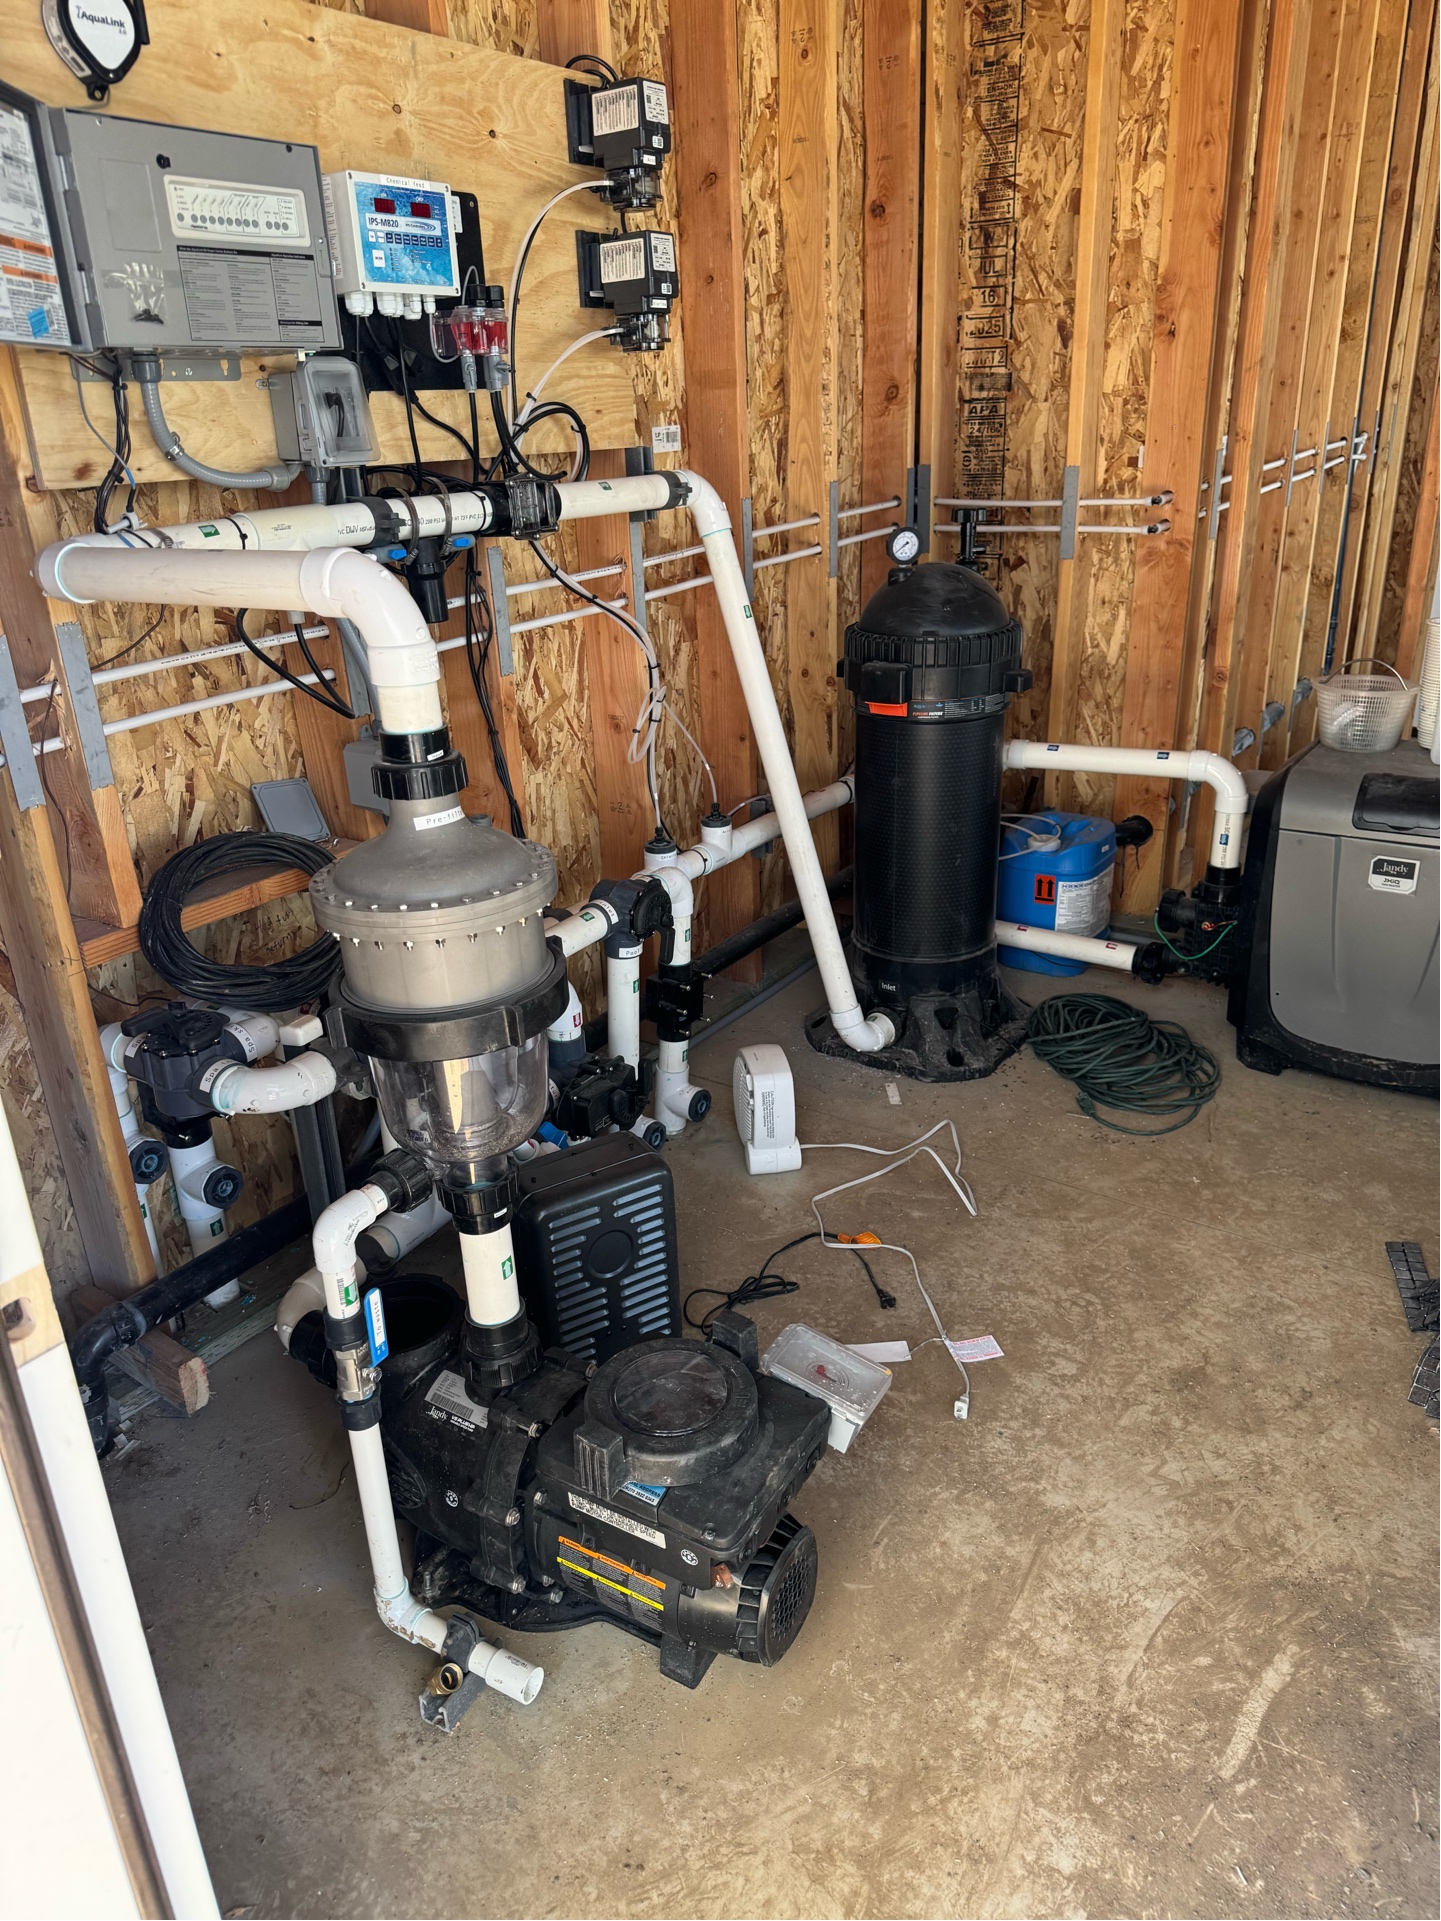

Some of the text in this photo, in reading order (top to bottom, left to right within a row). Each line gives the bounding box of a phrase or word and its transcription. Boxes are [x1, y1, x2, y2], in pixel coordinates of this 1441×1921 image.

[368, 216, 399, 228] IPS-M820
[981, 289, 996, 303] 16
[969, 405, 998, 415] APA
[1382, 862, 1409, 875] Jandy
[881, 982, 896, 992] Inlet
[204, 1066, 219, 1084] Spa
[638, 1485, 661, 1498] ADDRESS
[565, 1540, 581, 1548] WARNING
